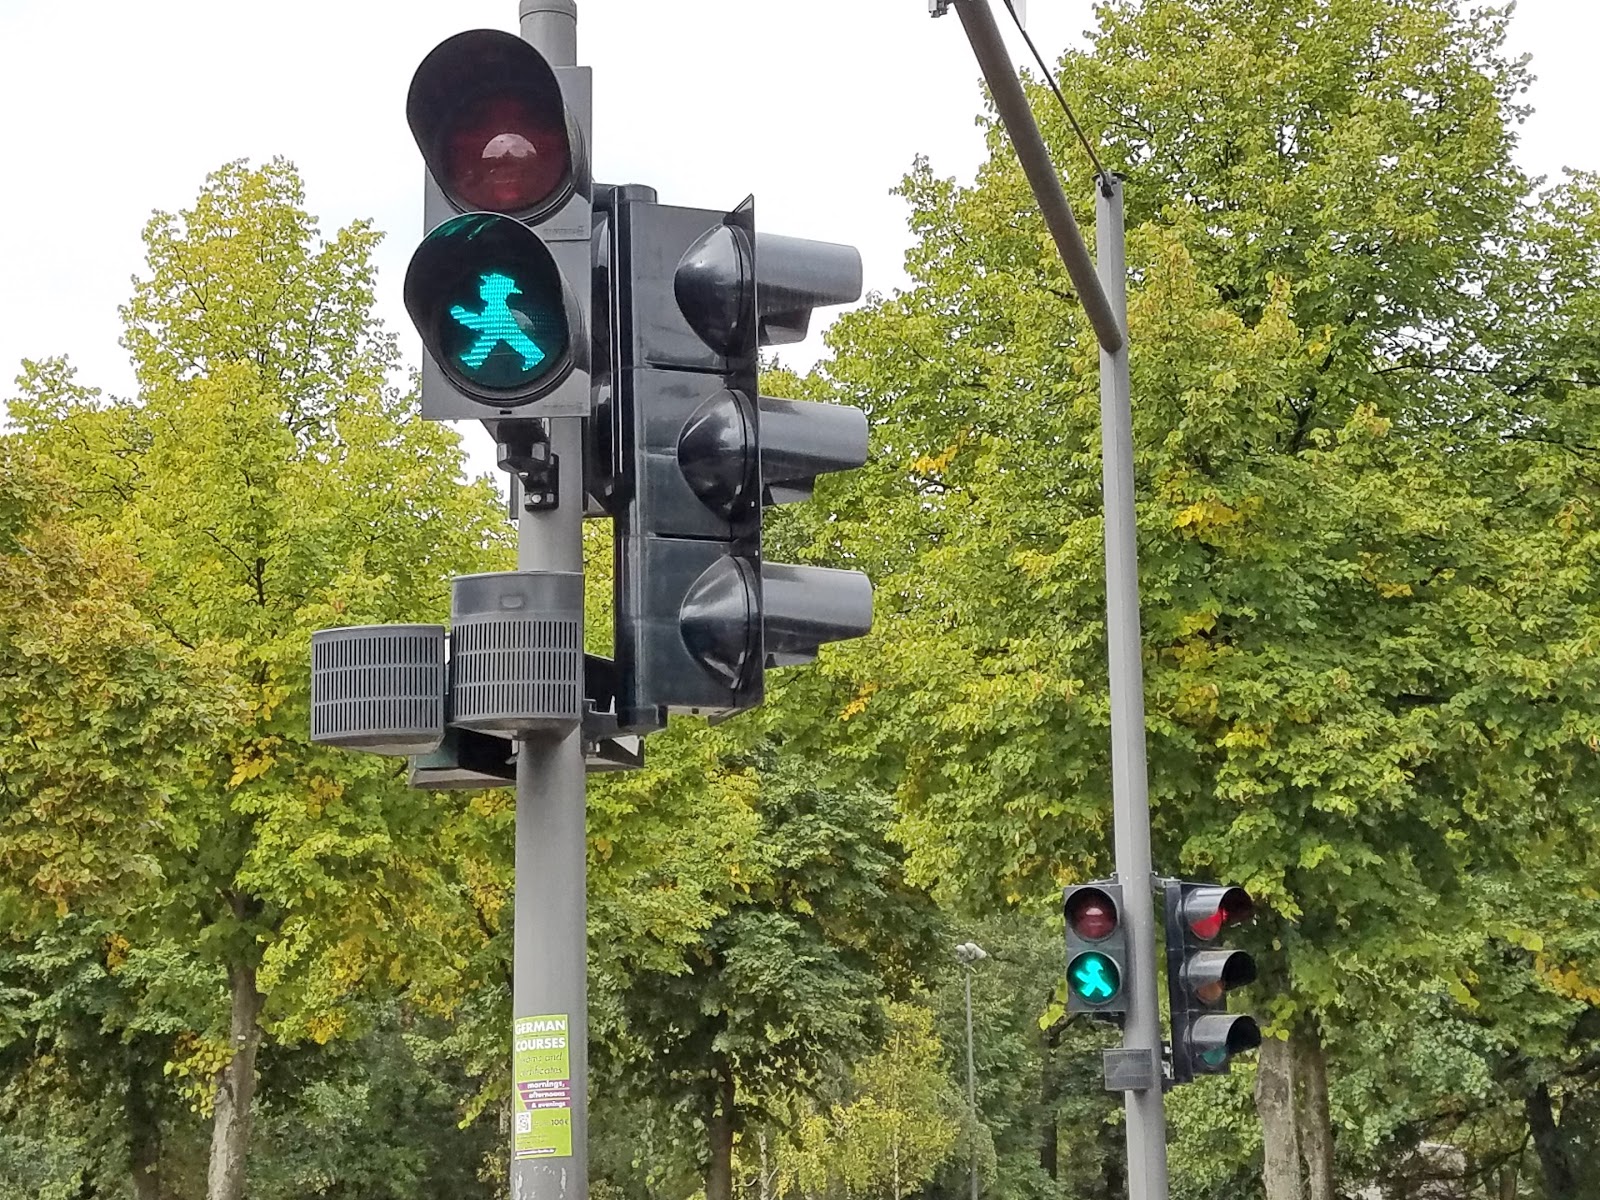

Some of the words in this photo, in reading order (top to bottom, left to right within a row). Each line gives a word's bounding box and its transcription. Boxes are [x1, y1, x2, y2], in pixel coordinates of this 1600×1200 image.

[515, 1020, 565, 1035] GERMAN
[515, 1037, 565, 1052] COURSES
[545, 1051, 562, 1061] and
[527, 1080, 565, 1089] mornings,
[528, 1091, 566, 1099] afternoons
